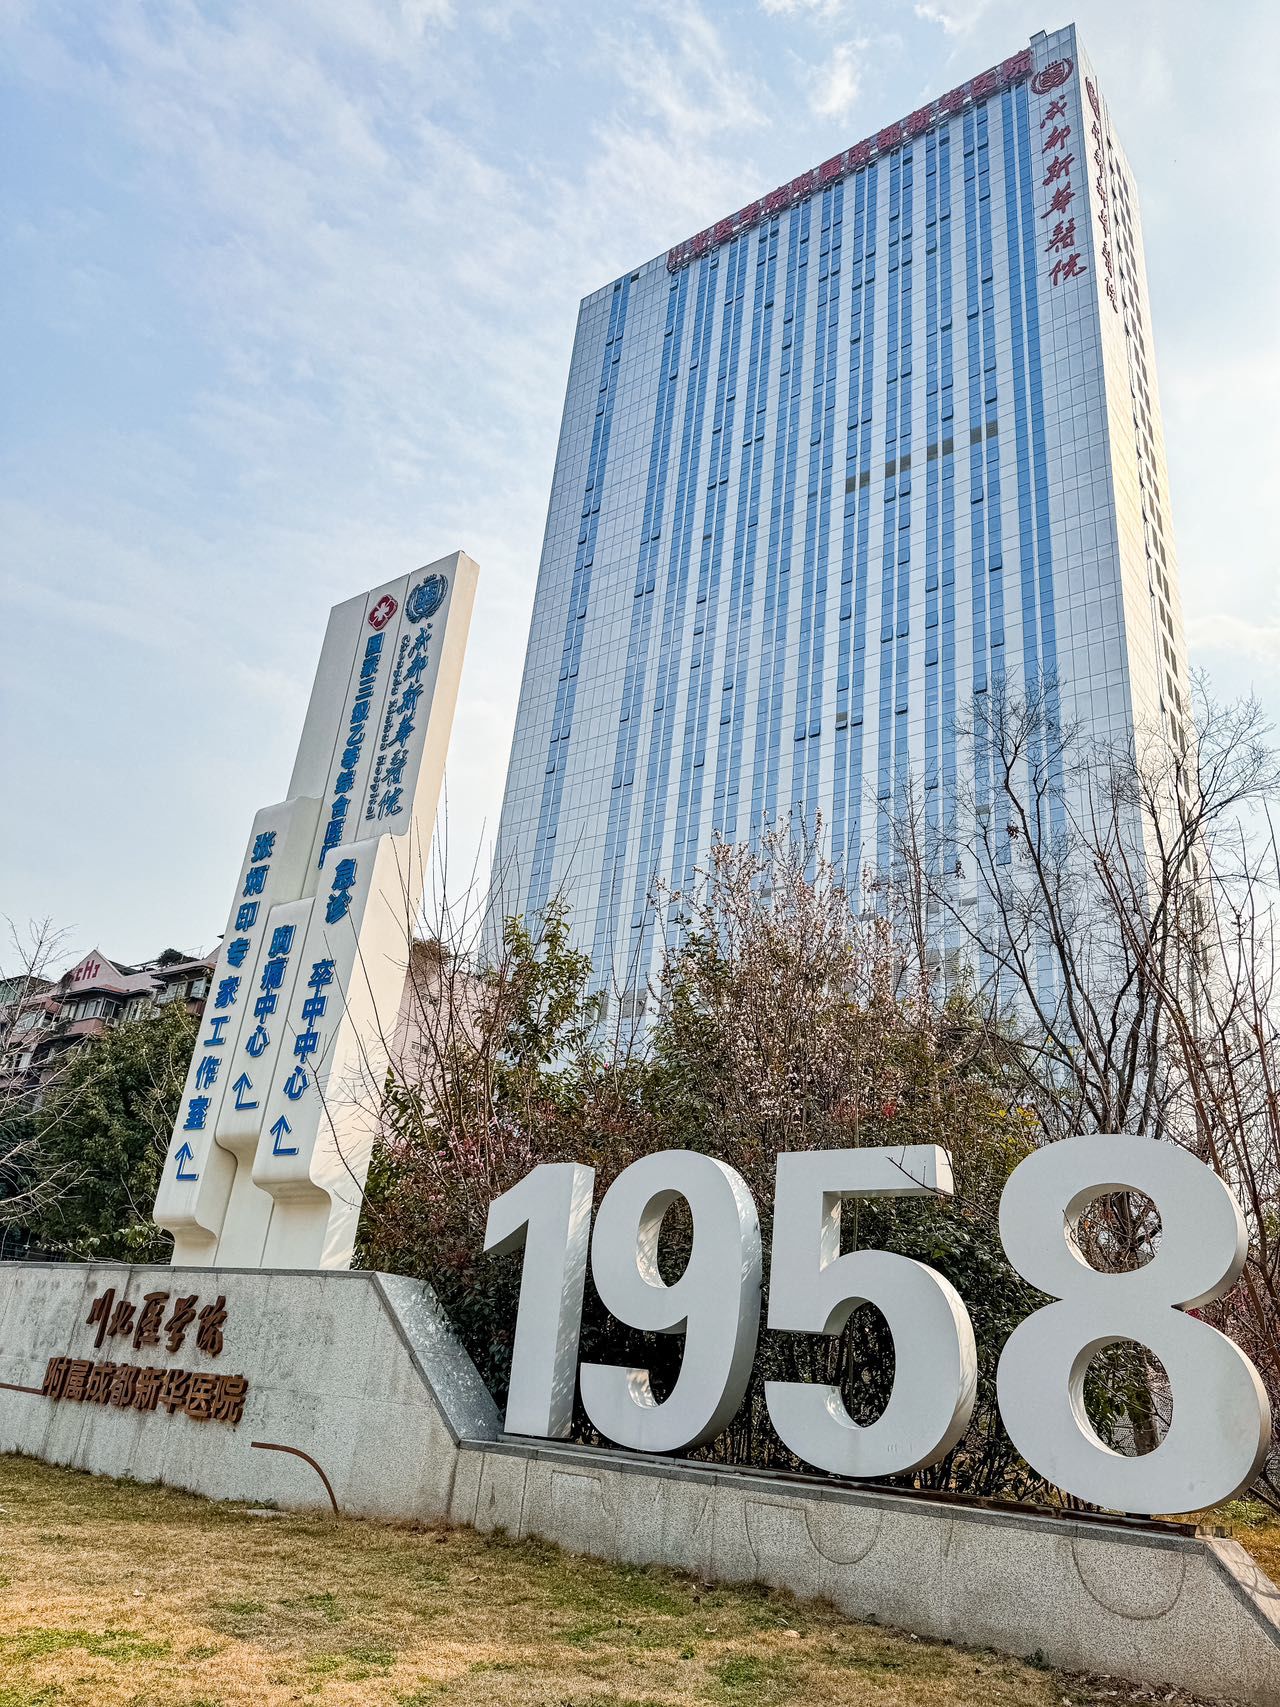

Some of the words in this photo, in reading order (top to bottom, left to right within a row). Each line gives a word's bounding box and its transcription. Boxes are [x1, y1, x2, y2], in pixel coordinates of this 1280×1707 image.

[391, 634, 411, 696] Chengdu
[380, 699, 399, 752] Xinhua
[365, 755, 388, 821] Hospital
[325, 858, 357, 924] 急诊
[183, 831, 277, 1130] 张炳印专家工作室
[245, 924, 297, 1057] 胸痛中心
[283, 958, 337, 1101] 卒中中心
[483, 1133, 1271, 1515] 1958
[44, 1356, 249, 1424] 附属成都新华医院
